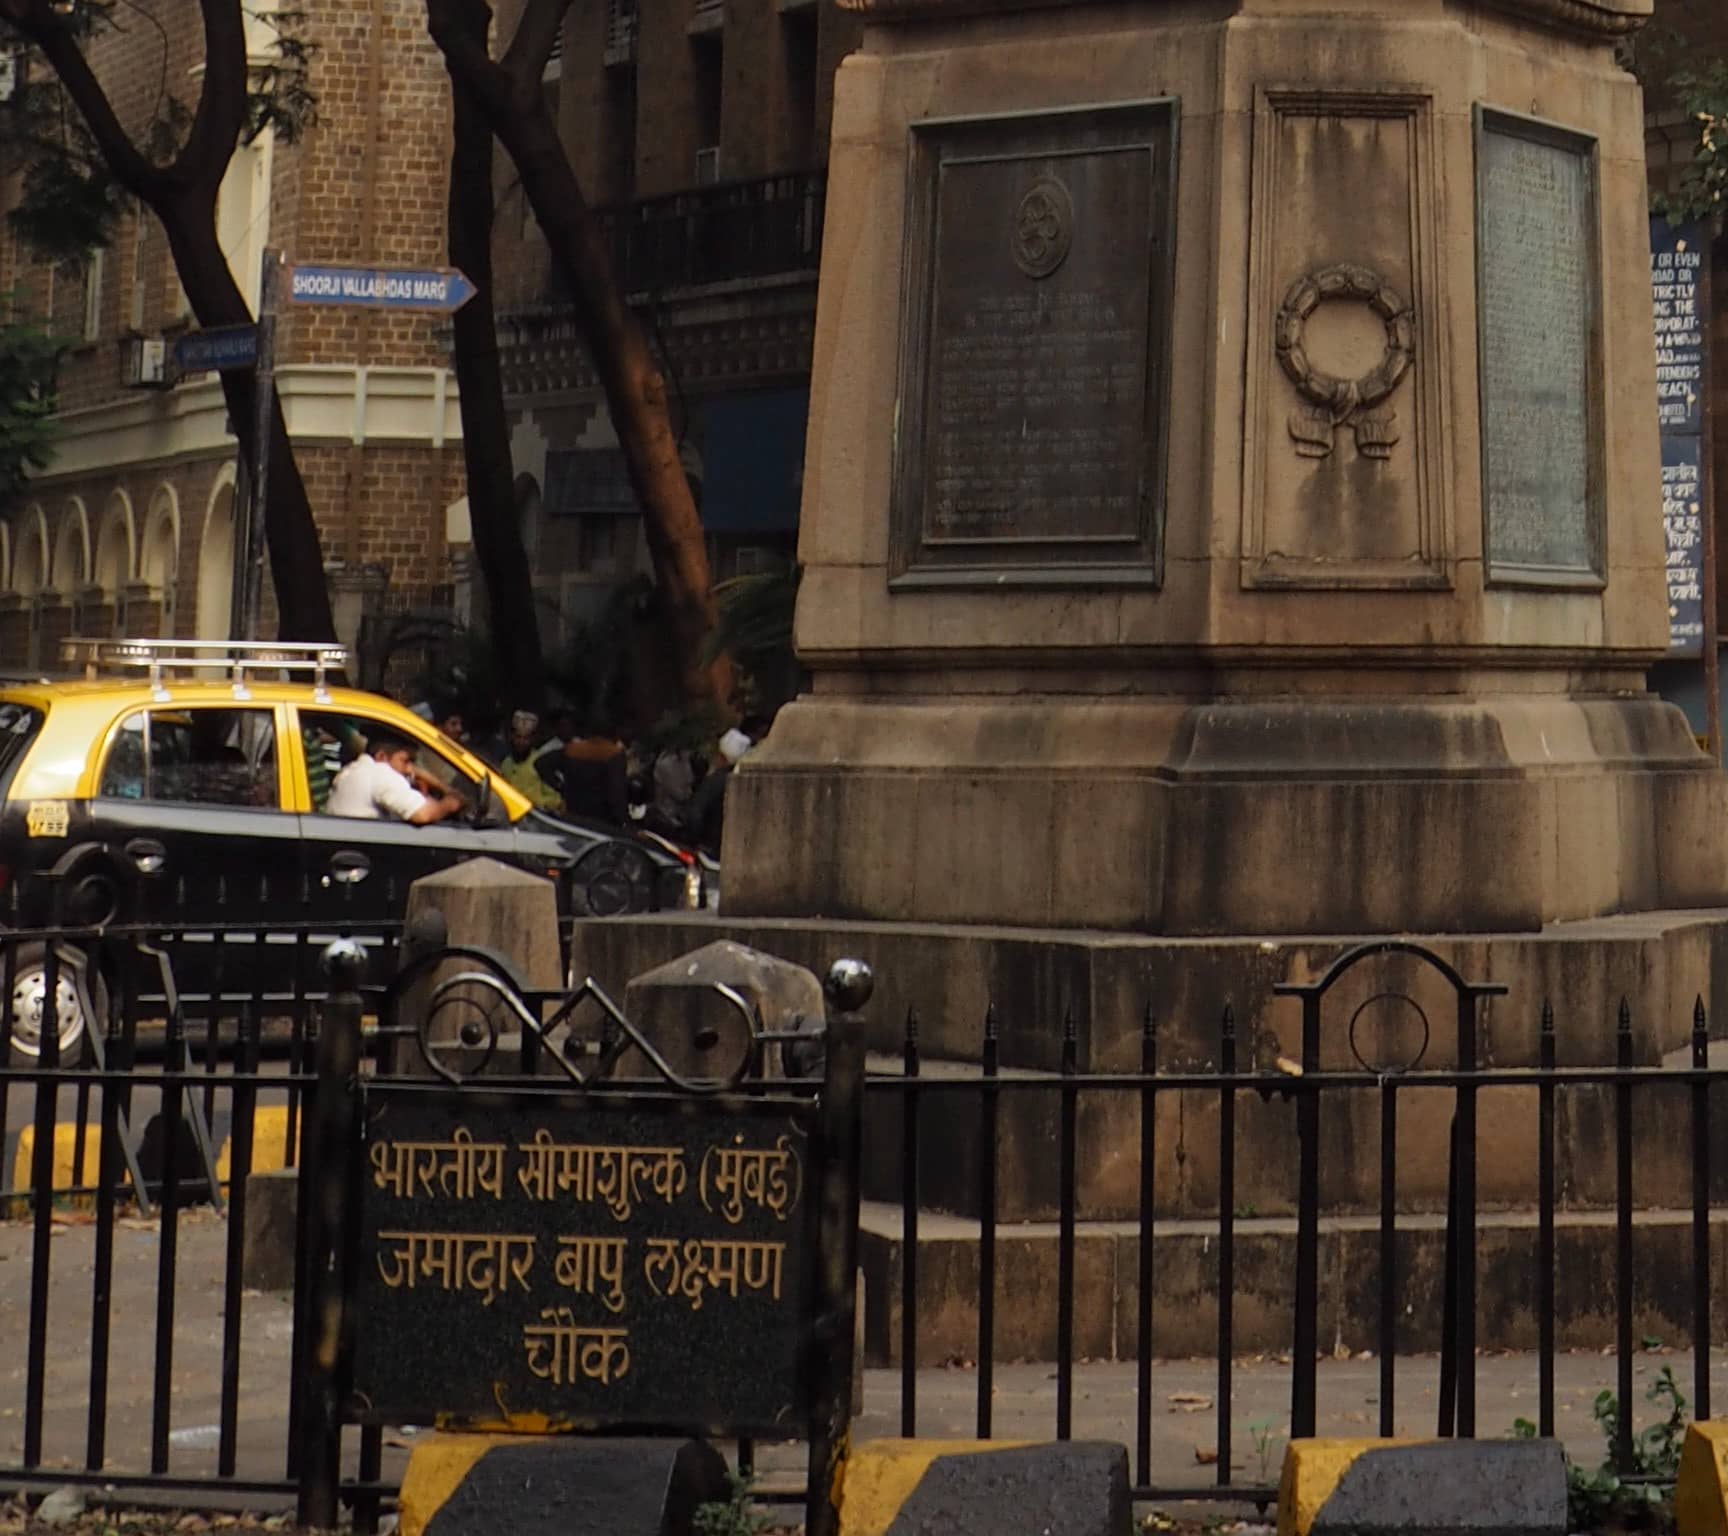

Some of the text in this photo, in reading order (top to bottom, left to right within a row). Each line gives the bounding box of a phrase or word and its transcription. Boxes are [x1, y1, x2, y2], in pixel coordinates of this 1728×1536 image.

[1658, 253, 1672, 268] OR
[1675, 252, 1700, 267] EVEN
[293, 275, 447, 301] SHOORJI VALLABHDAS MARG
[1678, 268, 1692, 282] OR
[1675, 300, 1695, 315] THE
[370, 1125, 804, 1224] भारतीय सीमाशुल्क (मुंबई)
[377, 1230, 787, 1314] जमादार बापु लक्ष्मण
[523, 1306, 631, 1386] चौक
